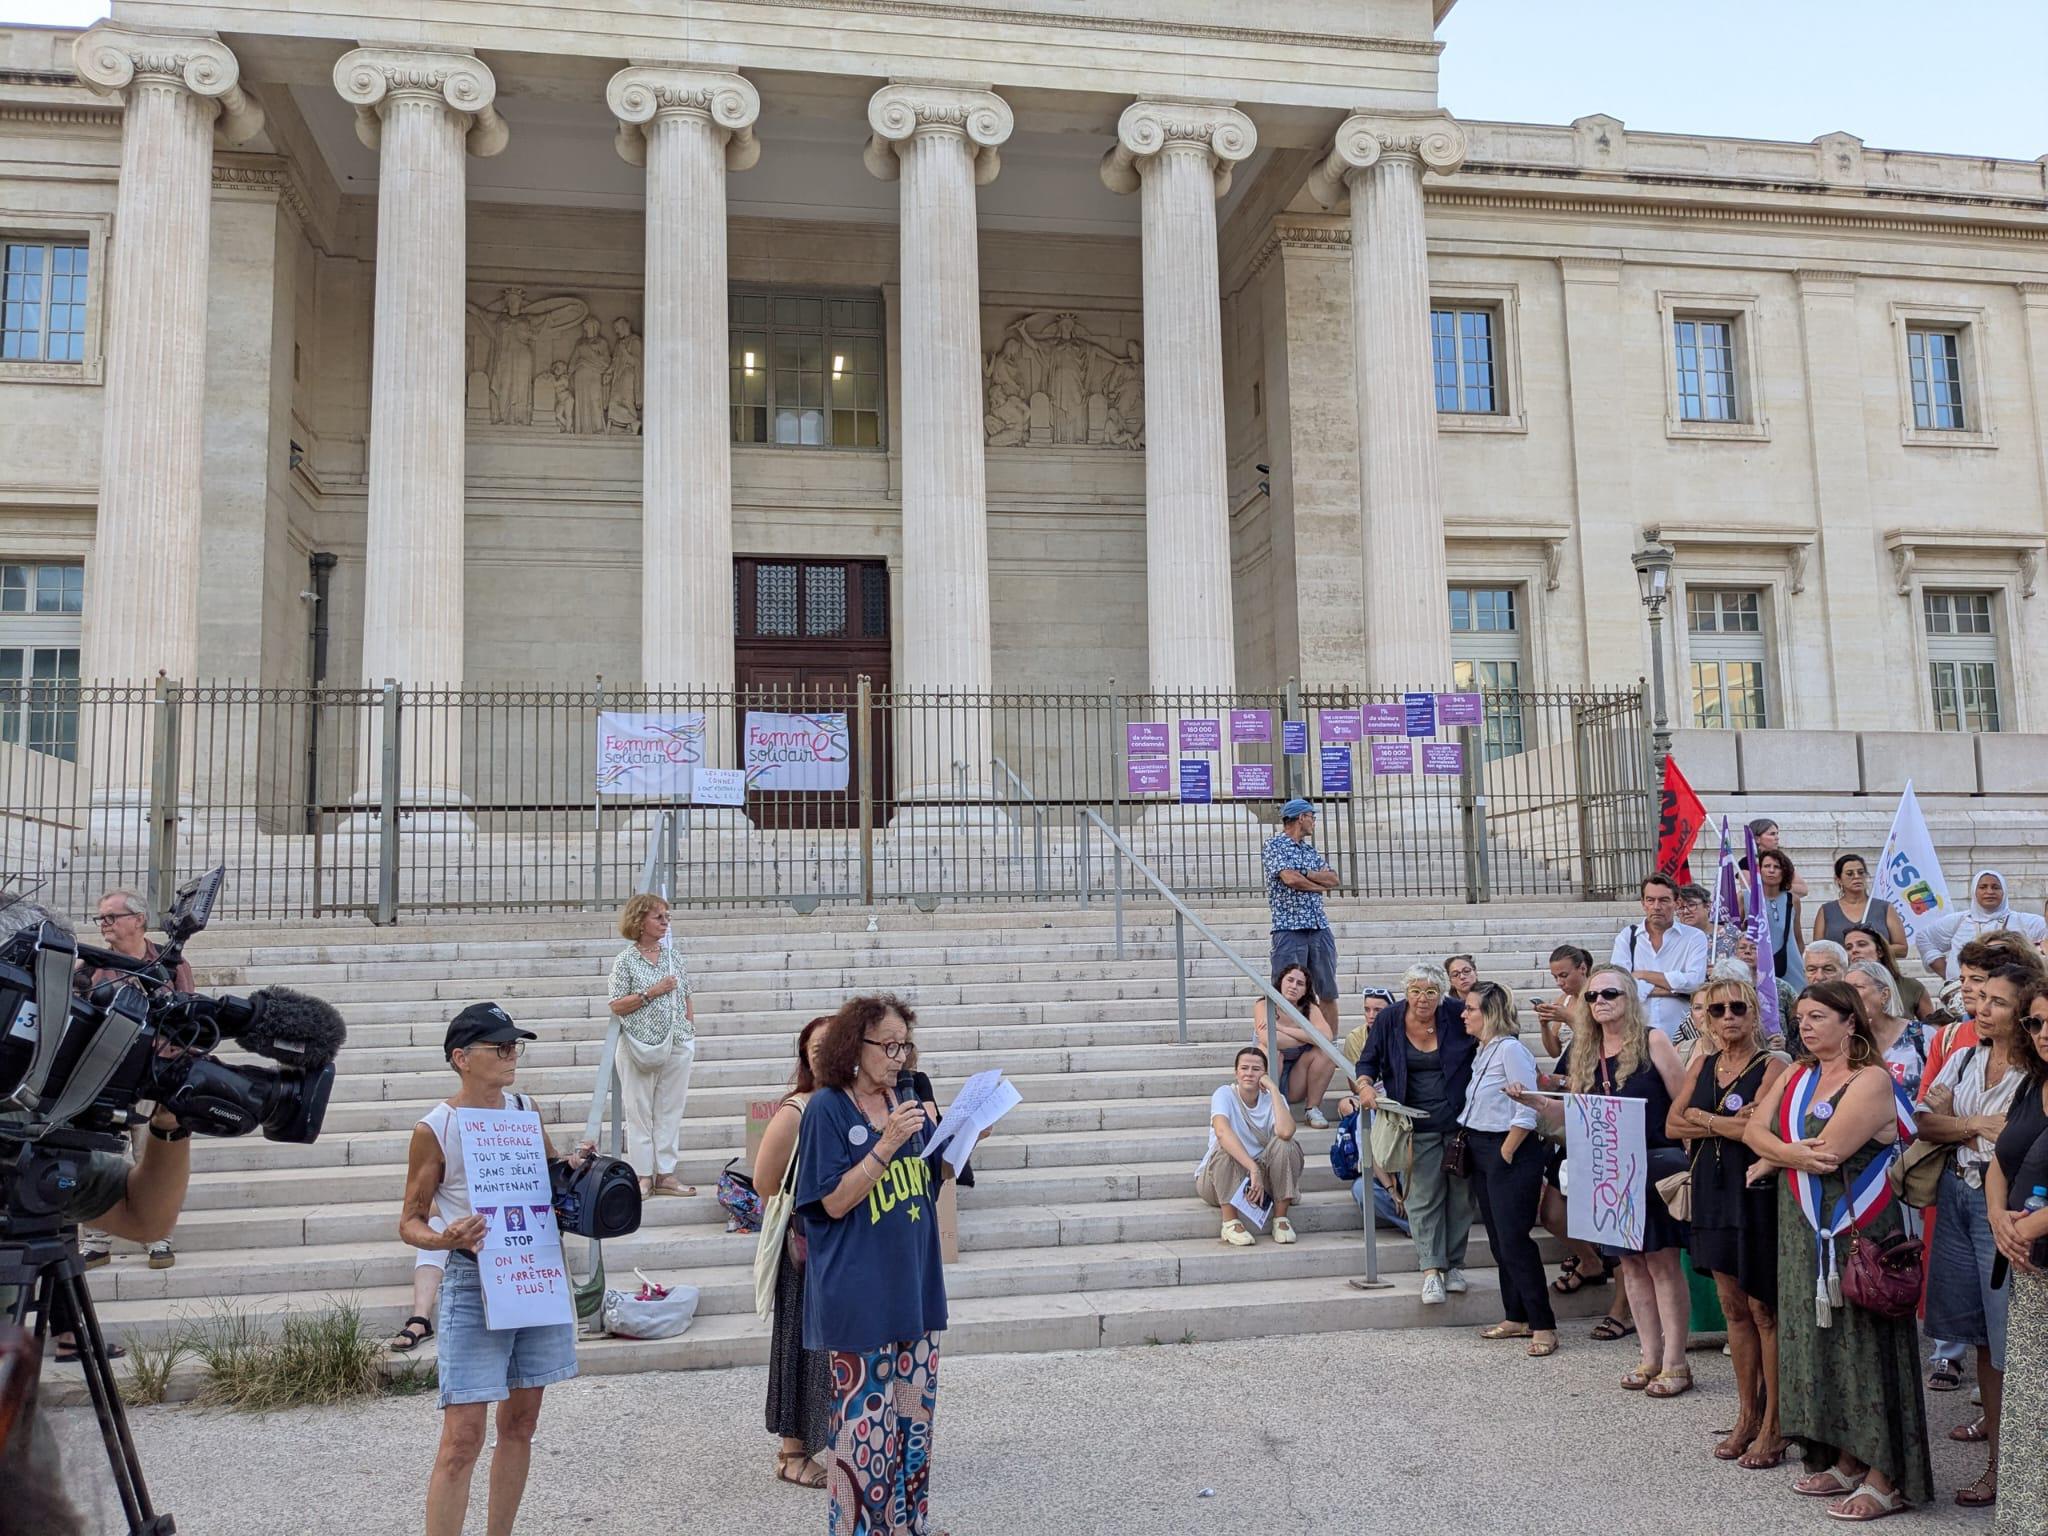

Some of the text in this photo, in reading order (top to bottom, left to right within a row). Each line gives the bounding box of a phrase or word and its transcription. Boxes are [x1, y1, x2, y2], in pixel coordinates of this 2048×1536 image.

[1890, 851, 1938, 915] FSU
[208, 1106, 242, 1122] FUJINON
[465, 1121, 486, 1132] UNE
[476, 1135, 533, 1147] INTÉGRALE
[472, 1152, 496, 1162] TOUT
[499, 1152, 511, 1162] DE
[479, 1167, 505, 1178] SANS
[504, 1235, 534, 1247] STOP
[495, 1254, 535, 1268] ON NE
[516, 1283, 545, 1294] PLUS
